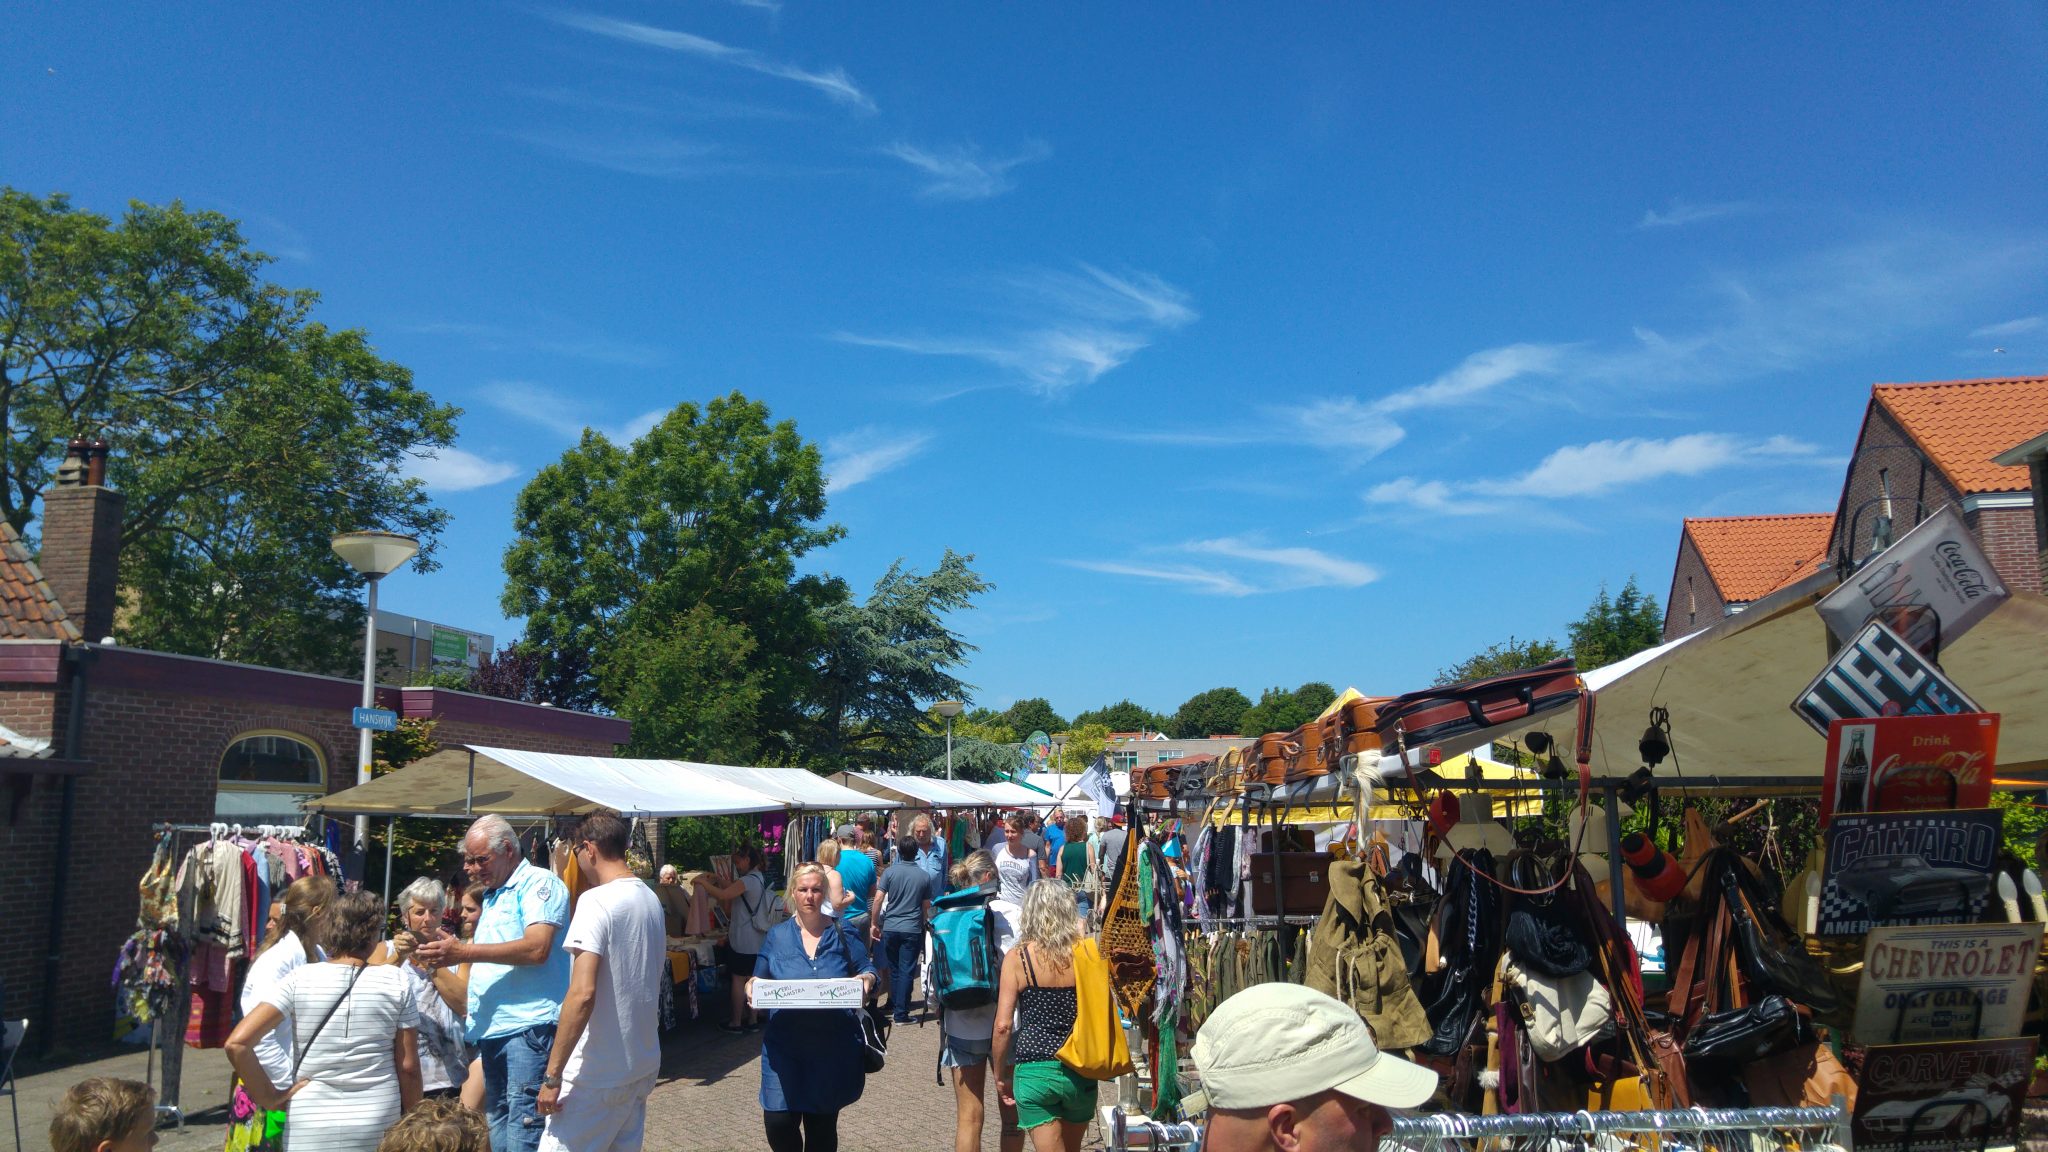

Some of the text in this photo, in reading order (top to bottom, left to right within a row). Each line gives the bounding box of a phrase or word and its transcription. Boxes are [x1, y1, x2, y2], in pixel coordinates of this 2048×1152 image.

[359, 711, 393, 728] HANSWIJK
[1912, 734, 1951, 747] Drink
[1830, 822, 1995, 875] CAMARO
[1931, 939, 1989, 949] THIS IS A
[1870, 937, 2035, 981] CHEVROLET
[1933, 988, 2009, 1007] GARAGE
[1869, 1049, 2028, 1084] CORVETTE
